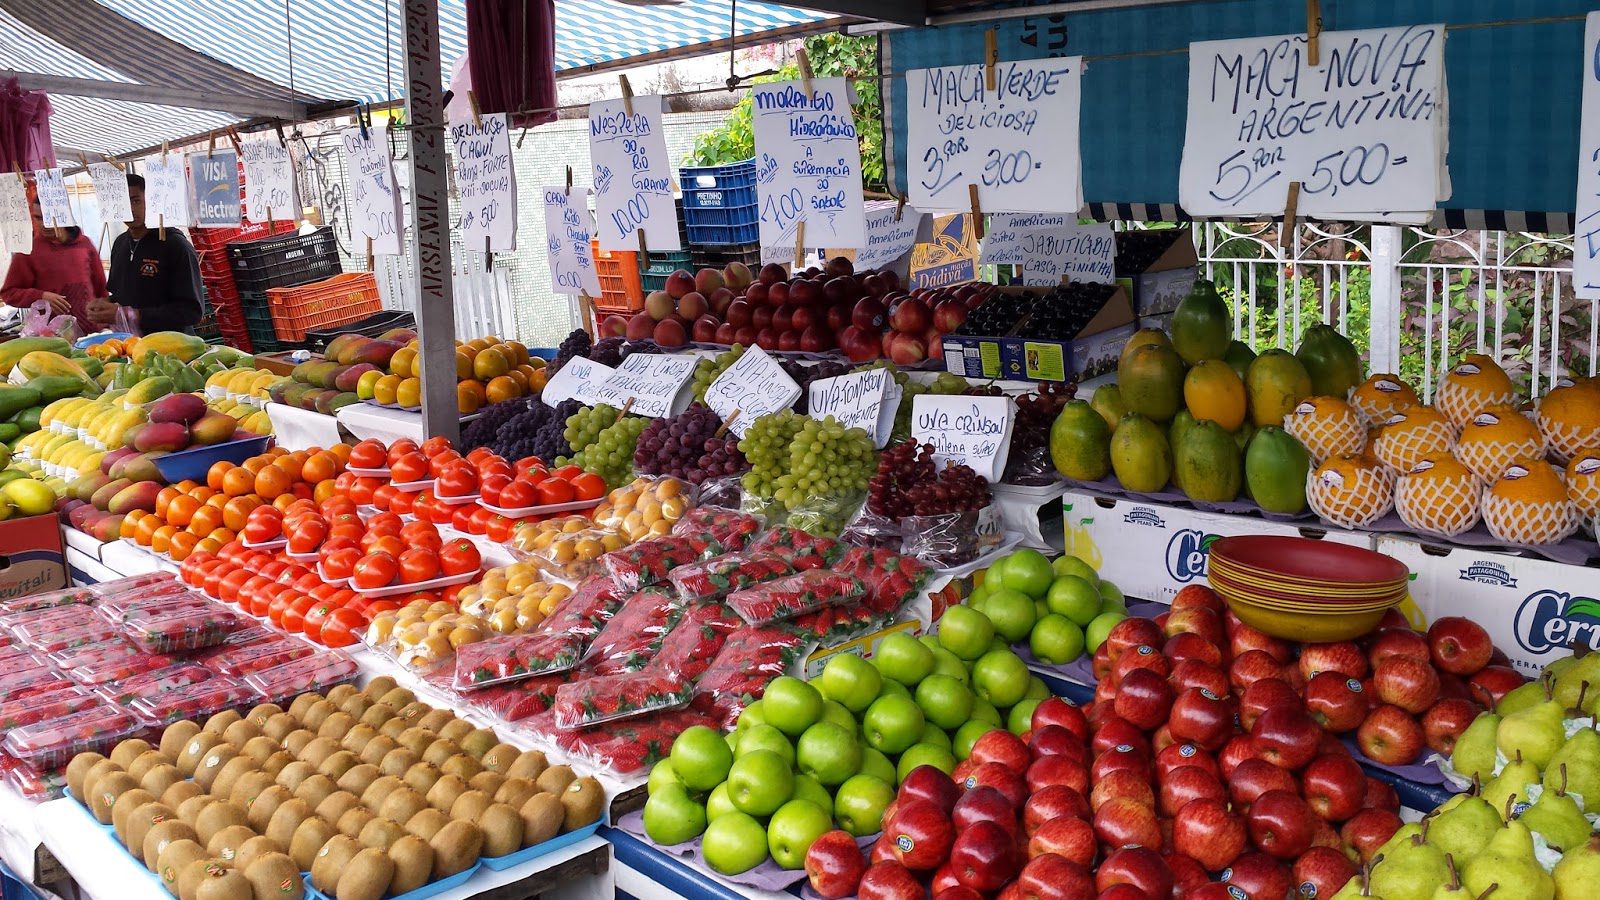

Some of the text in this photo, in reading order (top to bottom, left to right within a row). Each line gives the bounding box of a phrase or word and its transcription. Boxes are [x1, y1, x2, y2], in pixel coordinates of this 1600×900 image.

[998, 63, 1070, 102] VERDE
[939, 104, 1038, 136] DELICIOSA
[203, 161, 229, 181] VISA
[922, 147, 944, 190] 3
[1209, 150, 1251, 201] 5
[697, 192, 722, 200] PRETINHO
[200, 200, 240, 218] Electron
[920, 267, 961, 289] Dádiva
[920, 408, 949, 430] UVA
[1469, 567, 1509, 581] PATAGONIAN
[1472, 560, 1506, 571] ARGENTINE
[1477, 577, 1499, 586] PEARS
